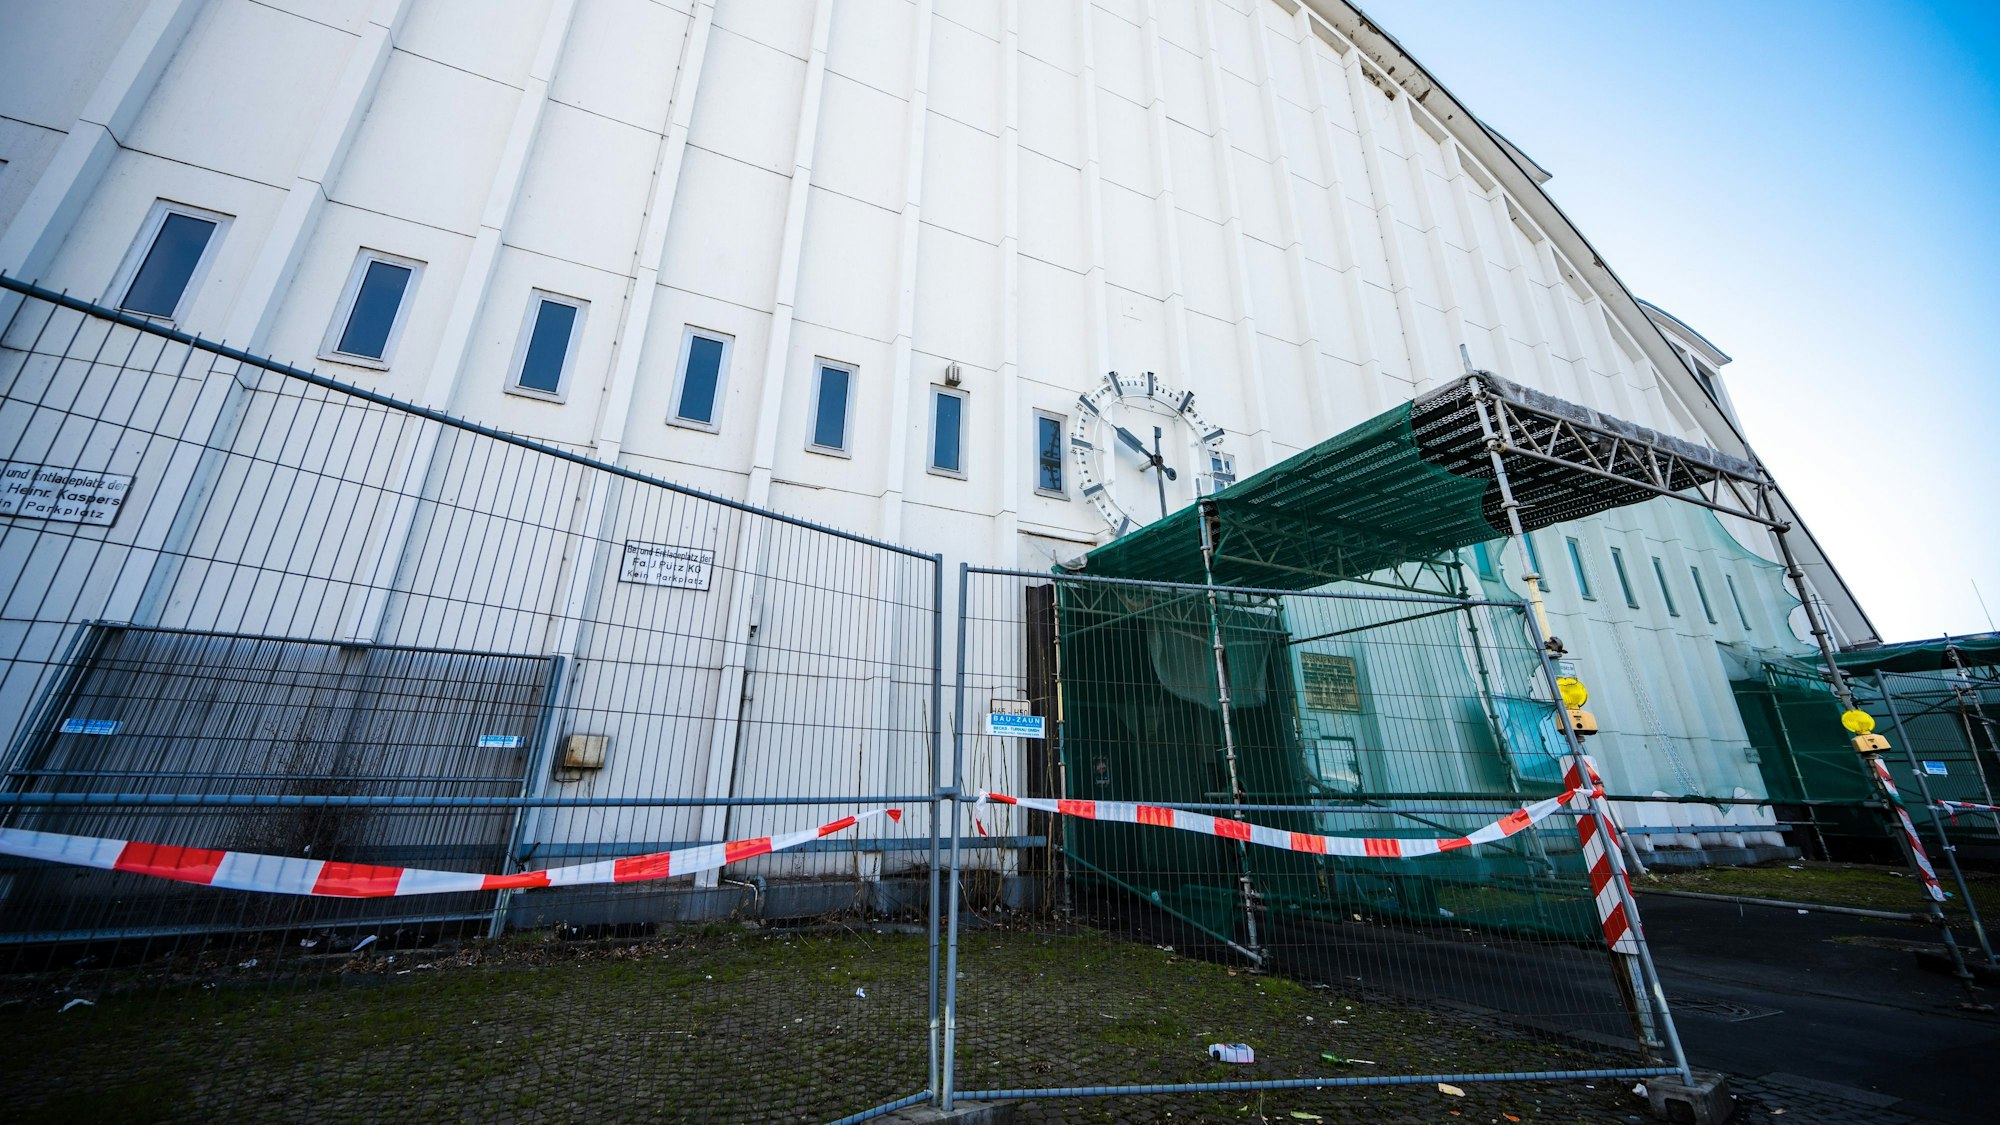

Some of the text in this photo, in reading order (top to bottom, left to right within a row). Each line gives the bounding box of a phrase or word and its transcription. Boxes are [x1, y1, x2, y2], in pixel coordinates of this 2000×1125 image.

[6, 468, 31, 479] und
[6, 483, 121, 506] Heinr. Kaspers
[25, 501, 105, 518] Parkplatz
[632, 558, 648, 567] Fa.
[627, 570, 703, 585] Kein Parkplatz
